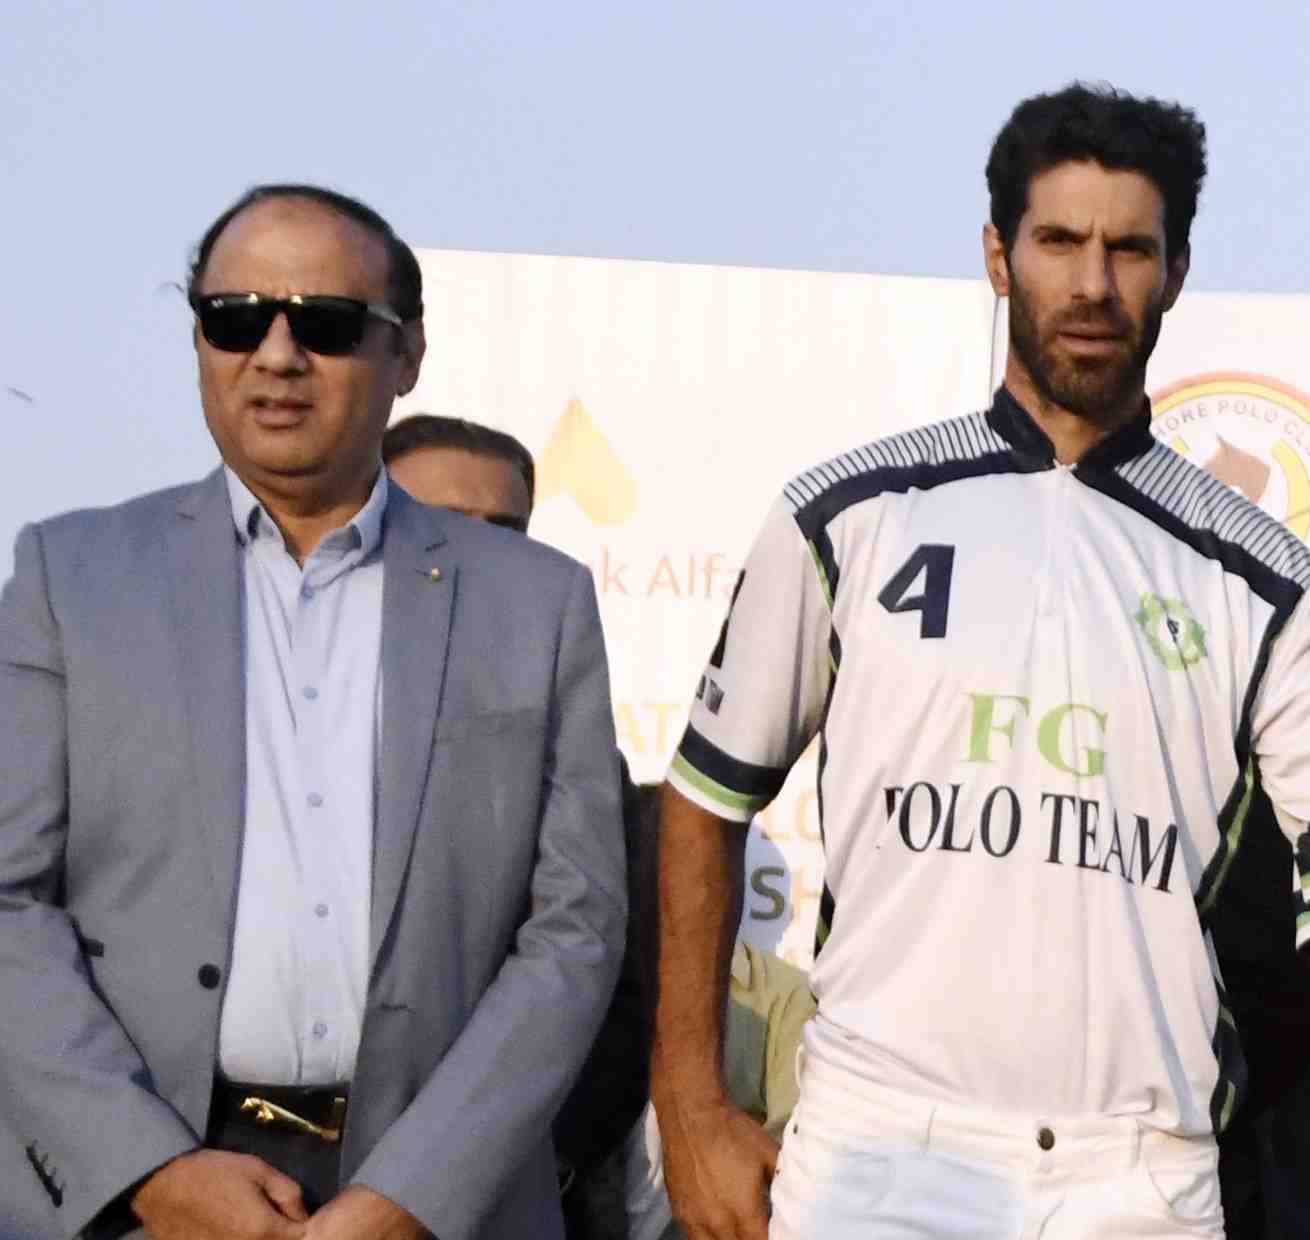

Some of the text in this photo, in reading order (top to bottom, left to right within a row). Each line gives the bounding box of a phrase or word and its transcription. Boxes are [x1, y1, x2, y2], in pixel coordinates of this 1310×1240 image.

[1216, 399, 1280, 425] POLO
[877, 543, 956, 639] 4
[961, 691, 1108, 781] FG
[1039, 791, 1178, 895] TEAM
